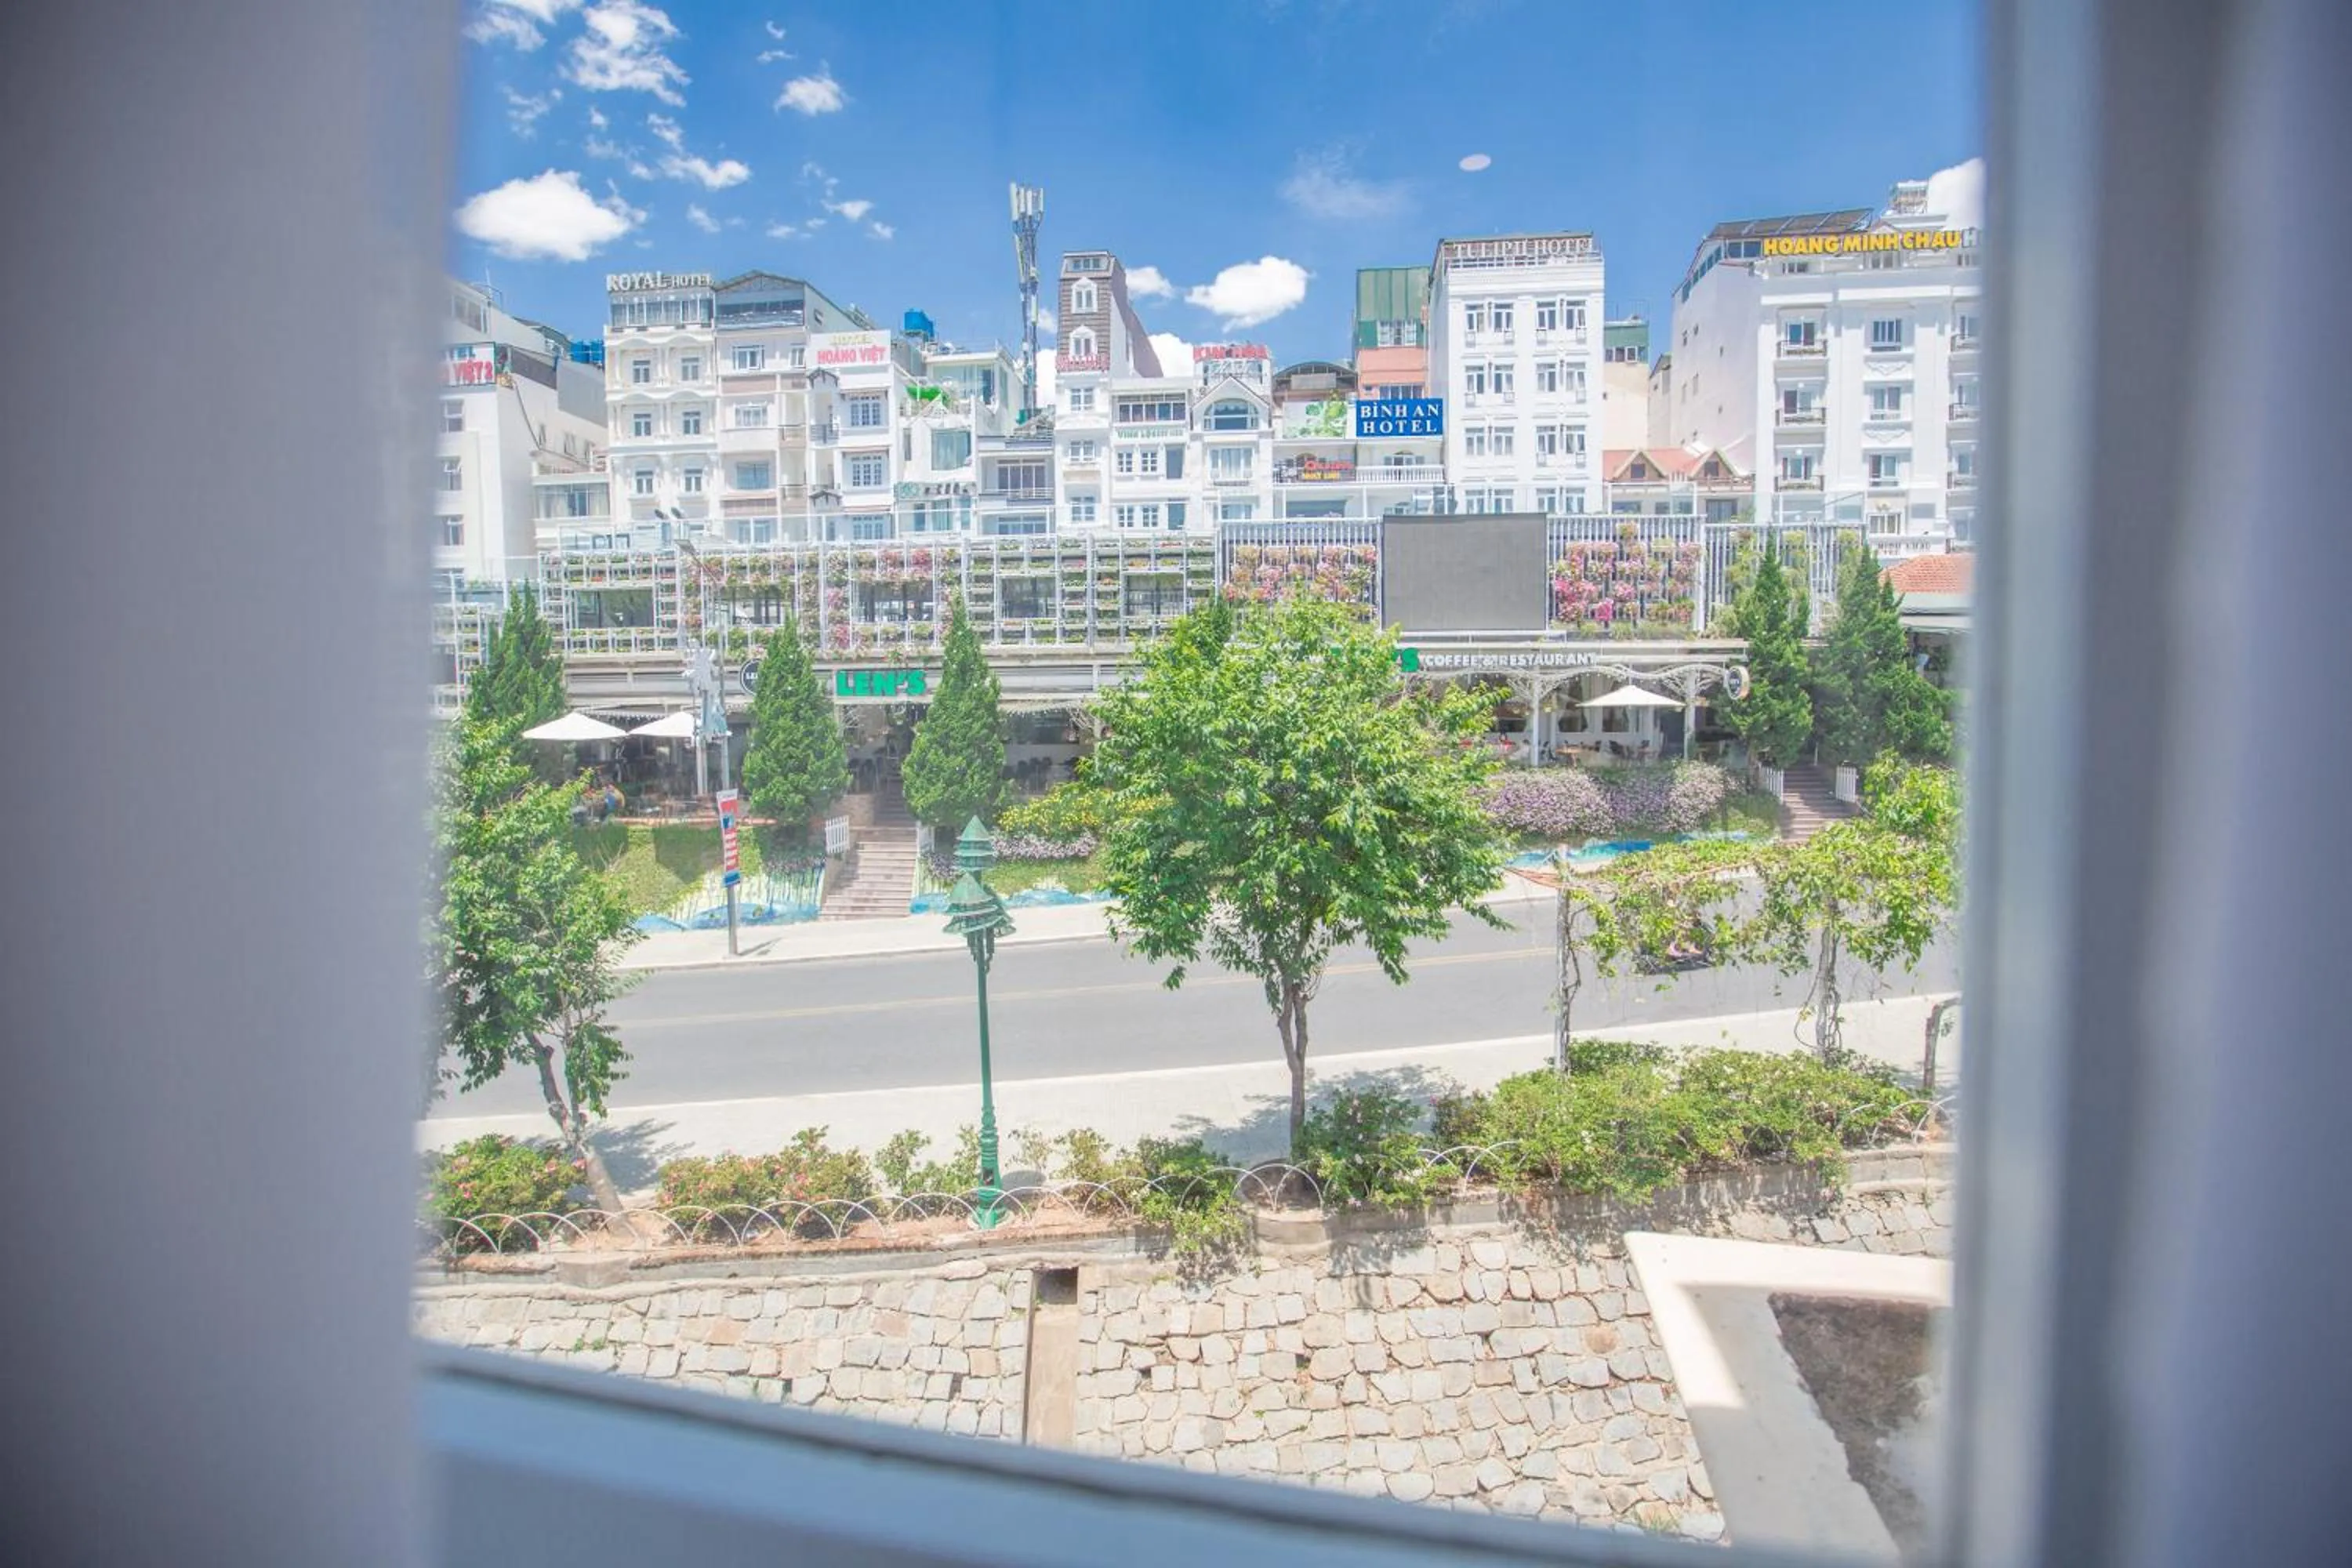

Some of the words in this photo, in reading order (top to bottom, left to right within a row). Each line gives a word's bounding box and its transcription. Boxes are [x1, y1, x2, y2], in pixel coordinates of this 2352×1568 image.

[1454, 241, 1513, 257] TULIP
[1534, 238, 1593, 255] HOTEL
[1764, 237, 1840, 255] HOANG
[1844, 233, 1899, 251] MINH
[606, 271, 666, 291] ROYAL
[1360, 402, 1408, 418] BÌNH
[1414, 404, 1439, 417] AN
[1363, 419, 1437, 434] HOTEL
[1425, 655, 1478, 666] COFFEE
[1498, 652, 1596, 666] RESTAURANT
[836, 670, 927, 696] LEN'S
